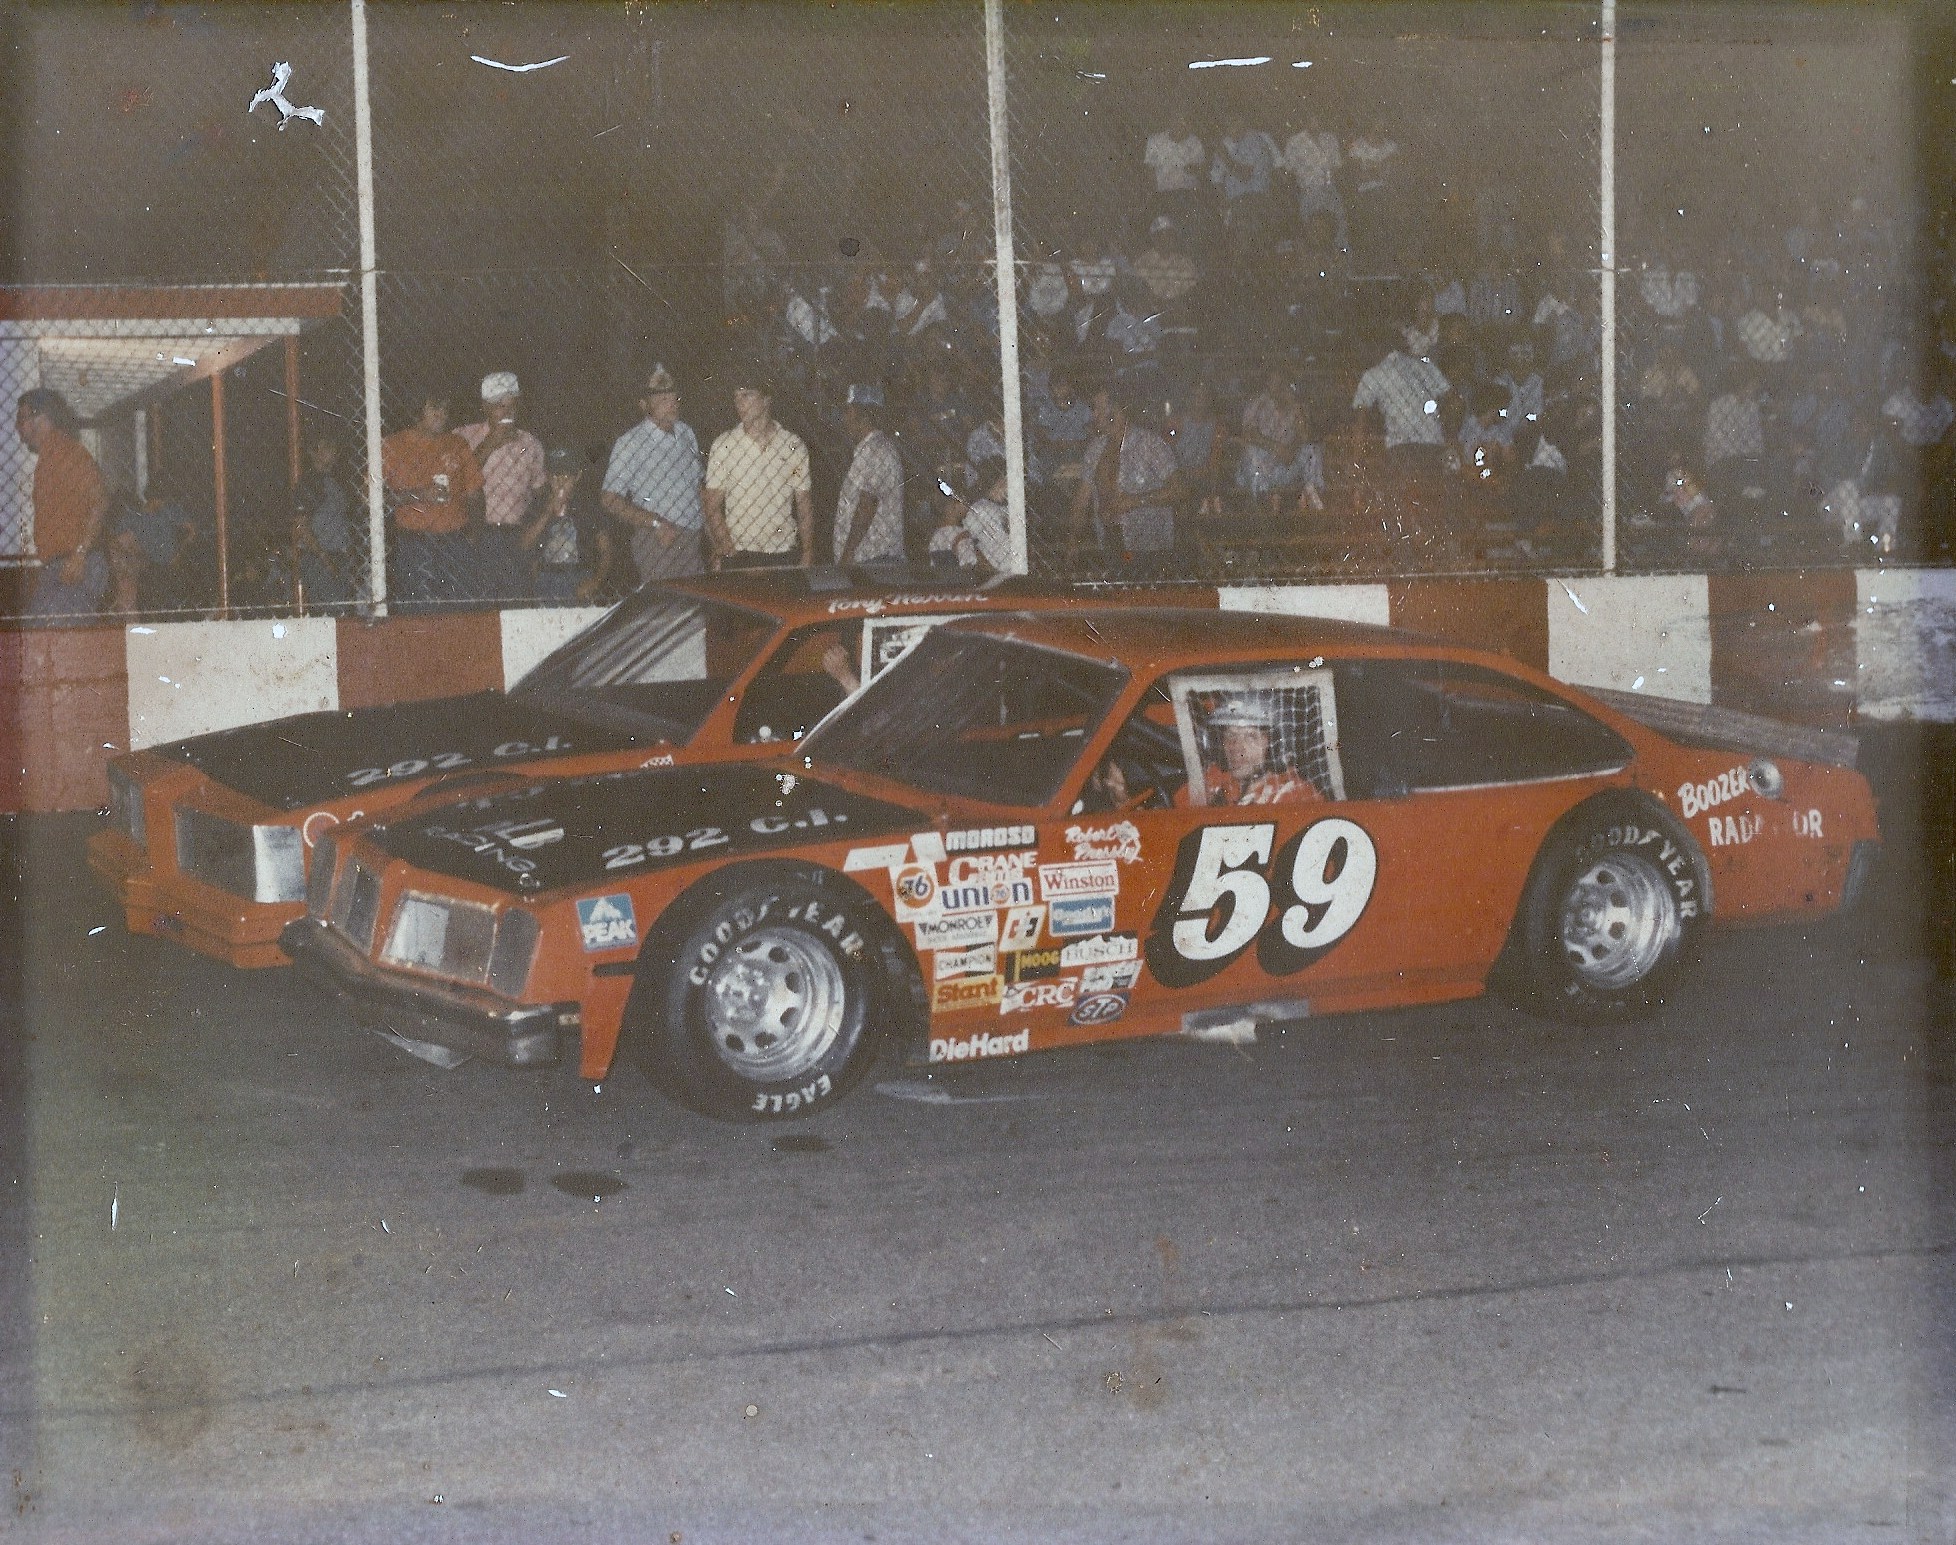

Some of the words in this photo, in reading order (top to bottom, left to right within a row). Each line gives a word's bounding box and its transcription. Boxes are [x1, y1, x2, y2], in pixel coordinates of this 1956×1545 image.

[347, 751, 472, 787] 292
[1678, 765, 1750, 818] BOOZER
[945, 825, 1035, 851] MOROSO
[1708, 809, 1824, 846] RADIOR
[602, 828, 730, 870] 292
[948, 851, 1038, 886] CRANE
[1043, 872, 1115, 890] Winston
[1172, 817, 1377, 961] 59
[583, 919, 637, 943] PEAK
[927, 917, 985, 934] MONROE
[937, 977, 998, 1004] Stant
[1021, 983, 1076, 1005] CRC
[1078, 998, 1119, 1018] STP
[929, 1028, 1030, 1062] DieHard
[751, 1074, 832, 1113] EAGLE
